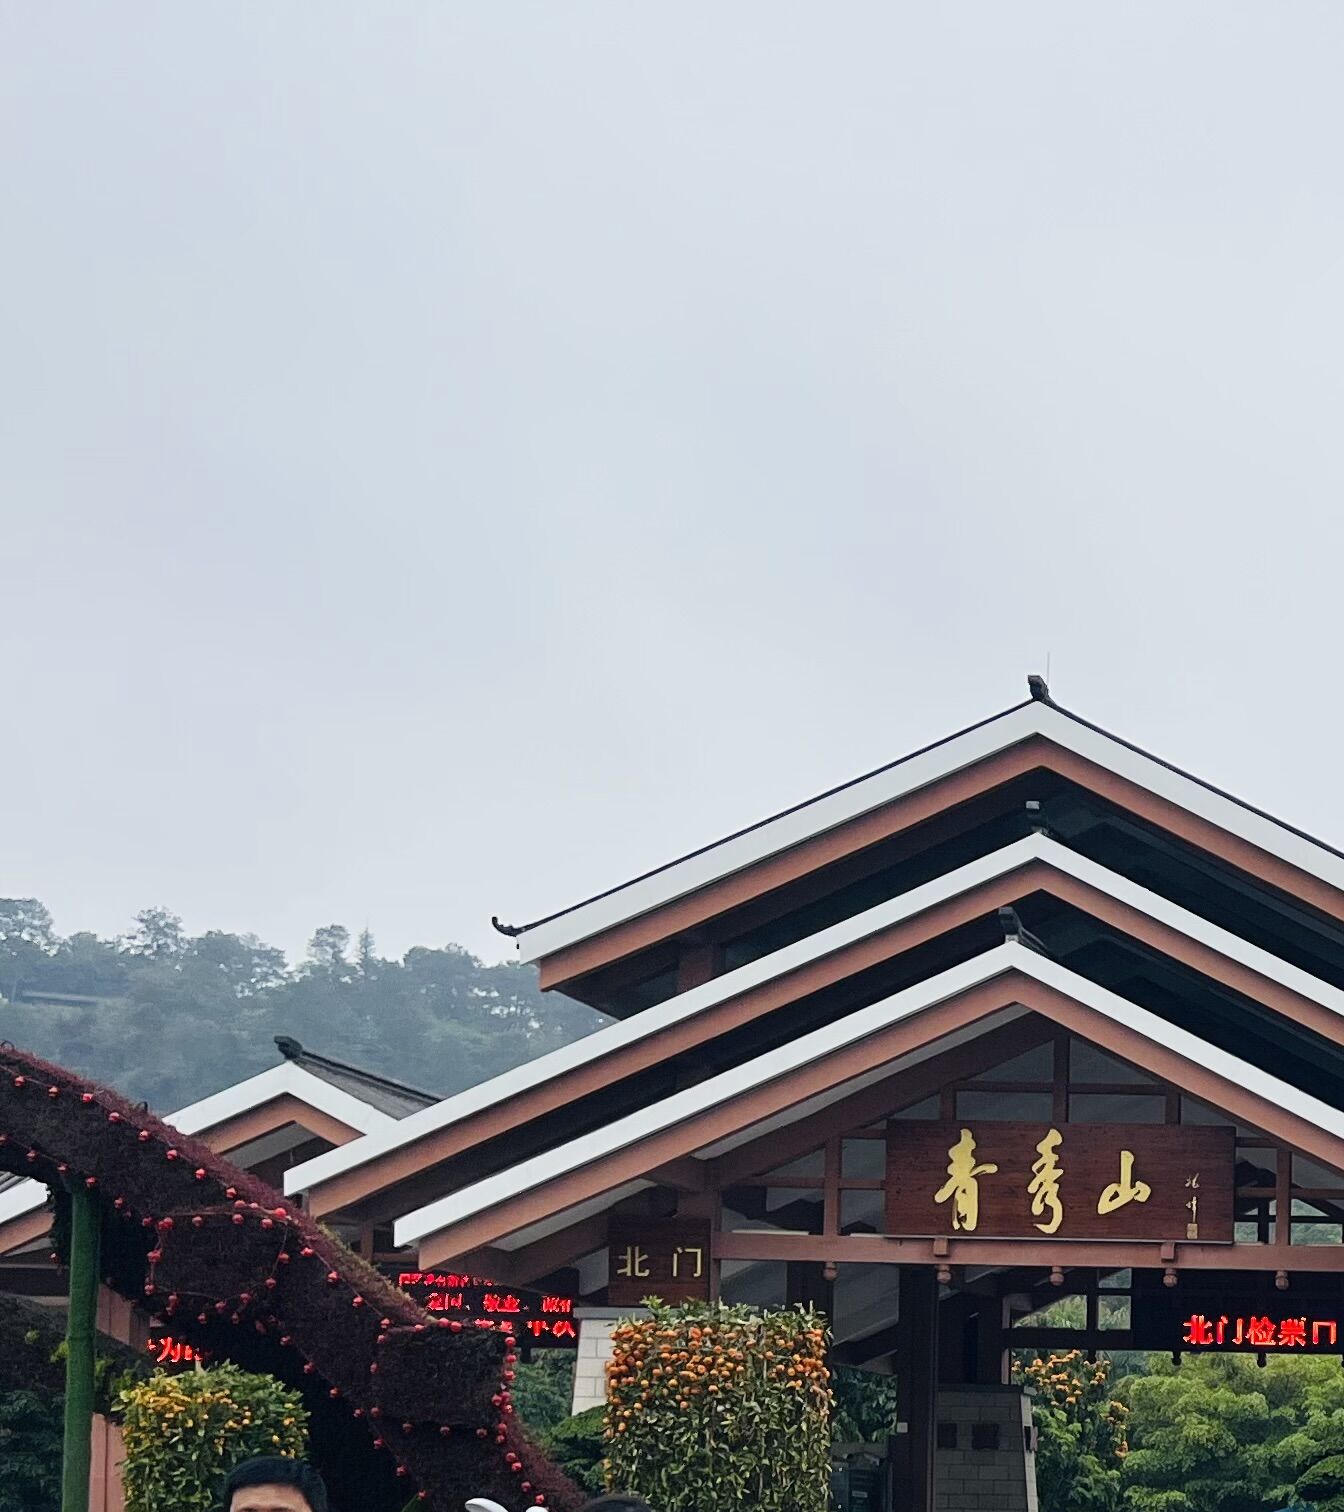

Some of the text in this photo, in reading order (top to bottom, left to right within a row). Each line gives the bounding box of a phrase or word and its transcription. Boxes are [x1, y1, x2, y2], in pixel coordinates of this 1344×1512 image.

[934, 1128, 1152, 1233] 青秀山
[617, 1246, 703, 1278] 北门
